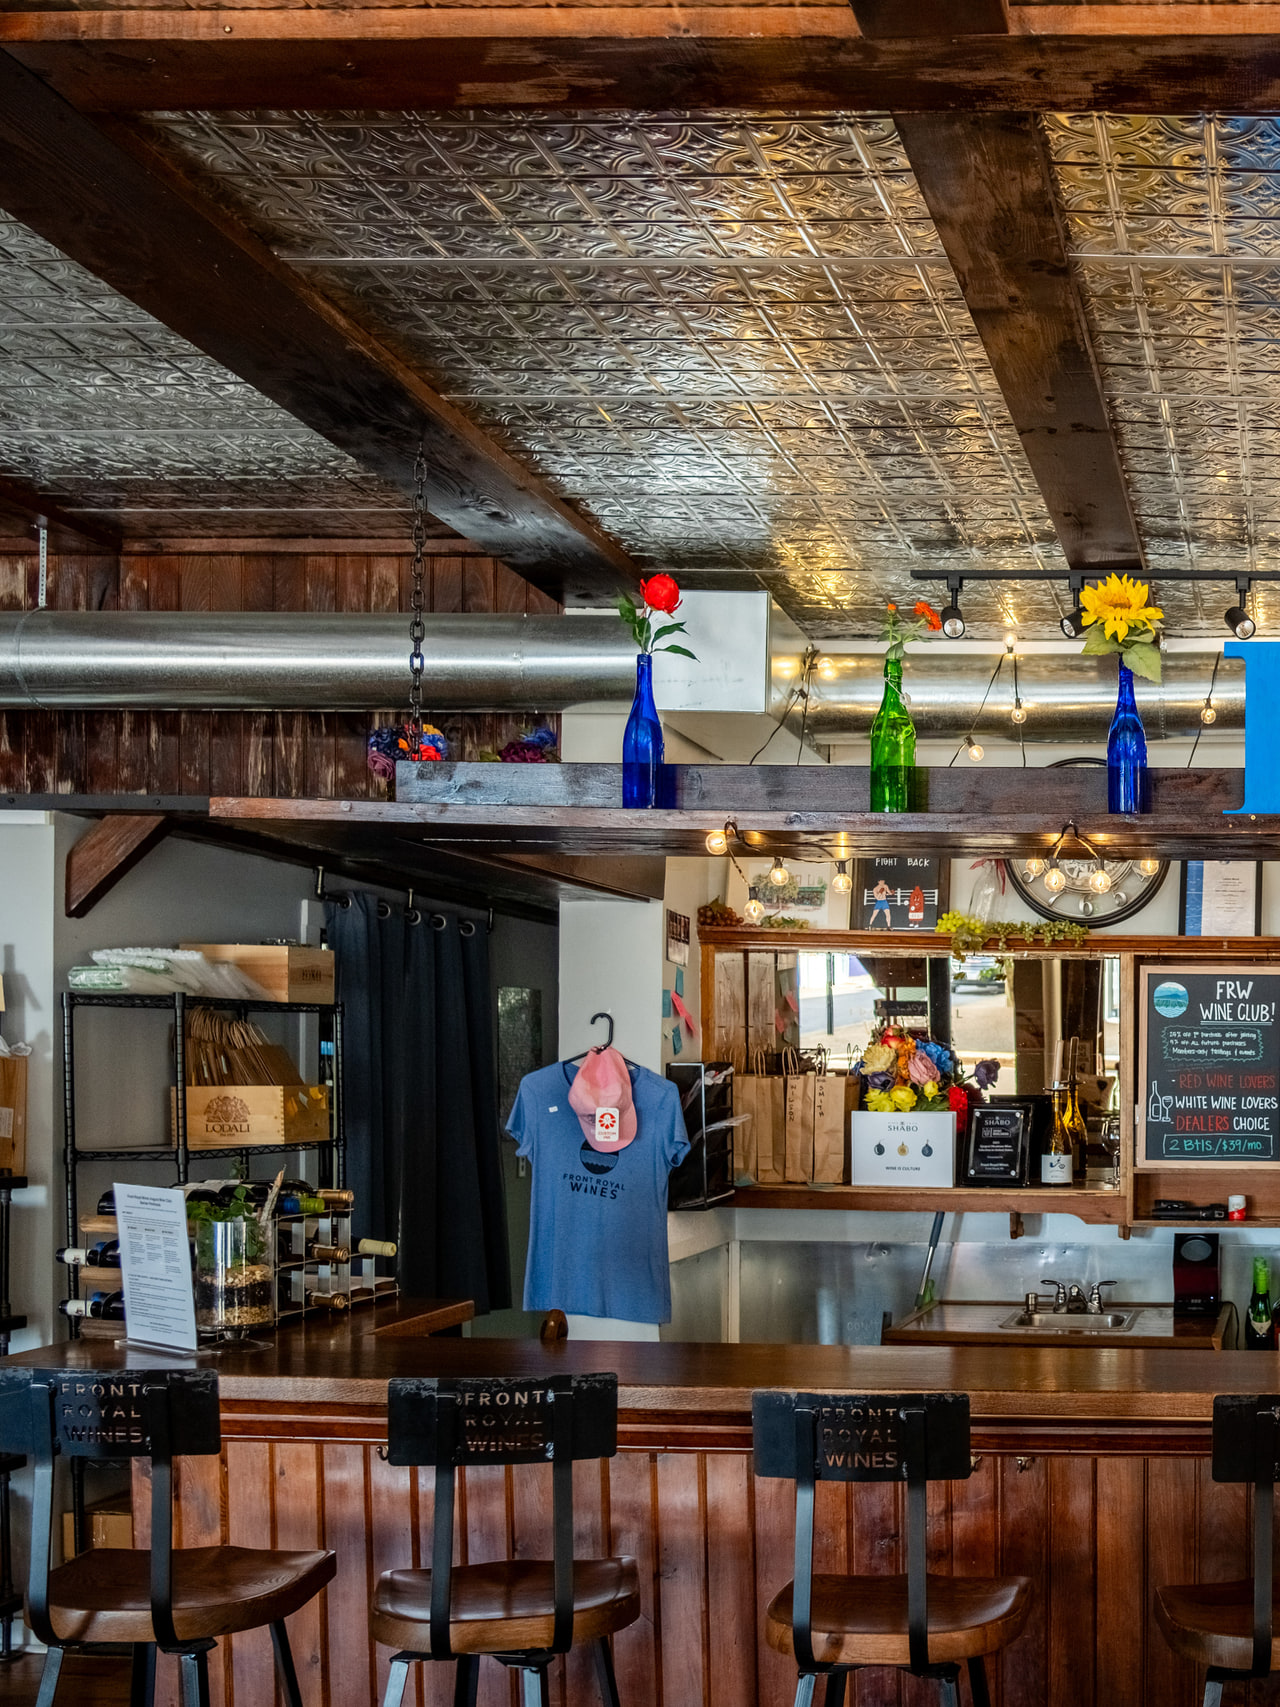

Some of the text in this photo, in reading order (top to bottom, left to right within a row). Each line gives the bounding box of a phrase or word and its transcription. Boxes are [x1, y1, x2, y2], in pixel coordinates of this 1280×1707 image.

[875, 857, 930, 867] FIGHT BACK
[1216, 981, 1254, 1000] FRW
[1199, 1002, 1276, 1022] WINE CLUB!
[1179, 1073, 1276, 1089] RED WINE LOVERS
[1175, 1096, 1279, 1110] WHITE WINE LOVERS
[205, 1123, 250, 1133] LODALI
[1176, 1115, 1270, 1131] DEALERS CHOICE
[1169, 1139, 1180, 1151] 2
[563, 1173, 625, 1191] FRONT ROYAL
[570, 1181, 618, 1200] WINES
[61, 1383, 141, 1398] FRONT
[464, 1390, 545, 1406] FRONT
[824, 1449, 898, 1468] WINES
